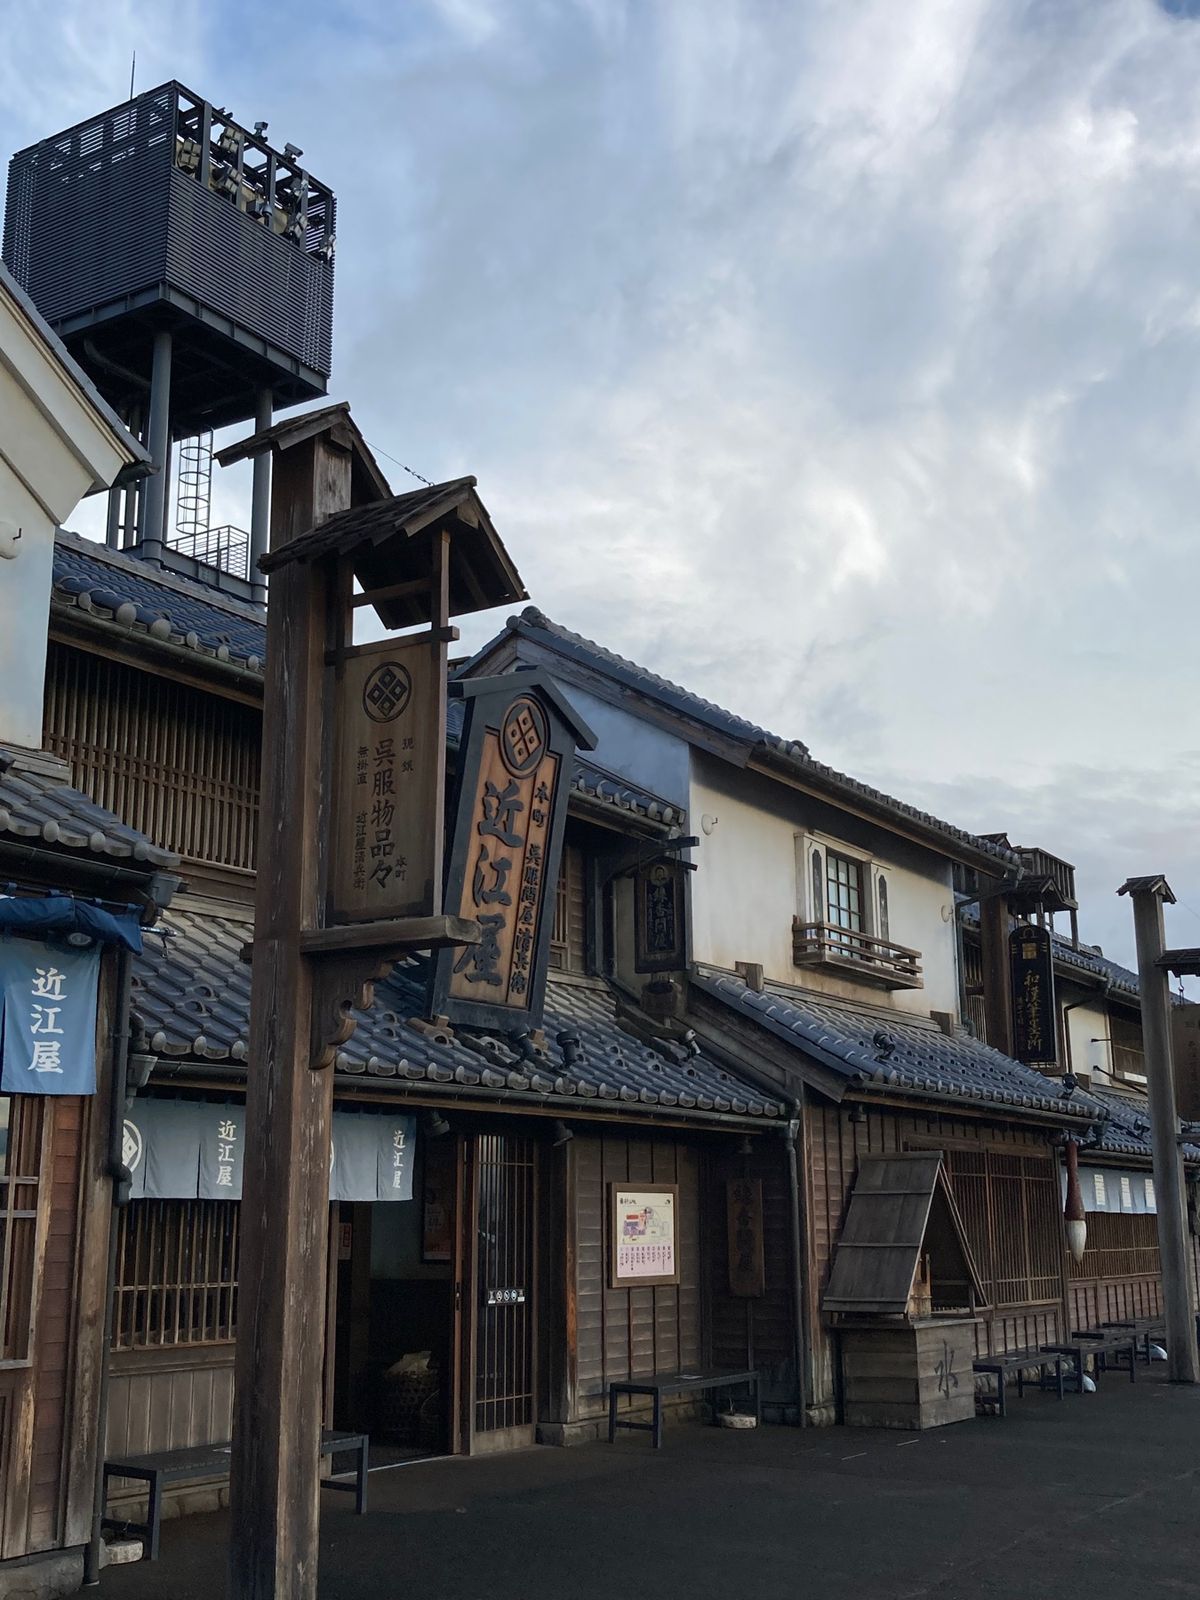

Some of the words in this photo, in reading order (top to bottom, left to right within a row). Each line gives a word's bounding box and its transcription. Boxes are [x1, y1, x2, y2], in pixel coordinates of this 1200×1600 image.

[369, 737, 397, 889] 呉服物品々
[532, 781, 550, 828] 本町
[453, 777, 525, 987] 近江屋
[27, 967, 67, 1075] 近江屋
[216, 1120, 238, 1187] 近江屋
[392, 1130, 406, 1189] 近江屋
[933, 1339, 959, 1400] 水
